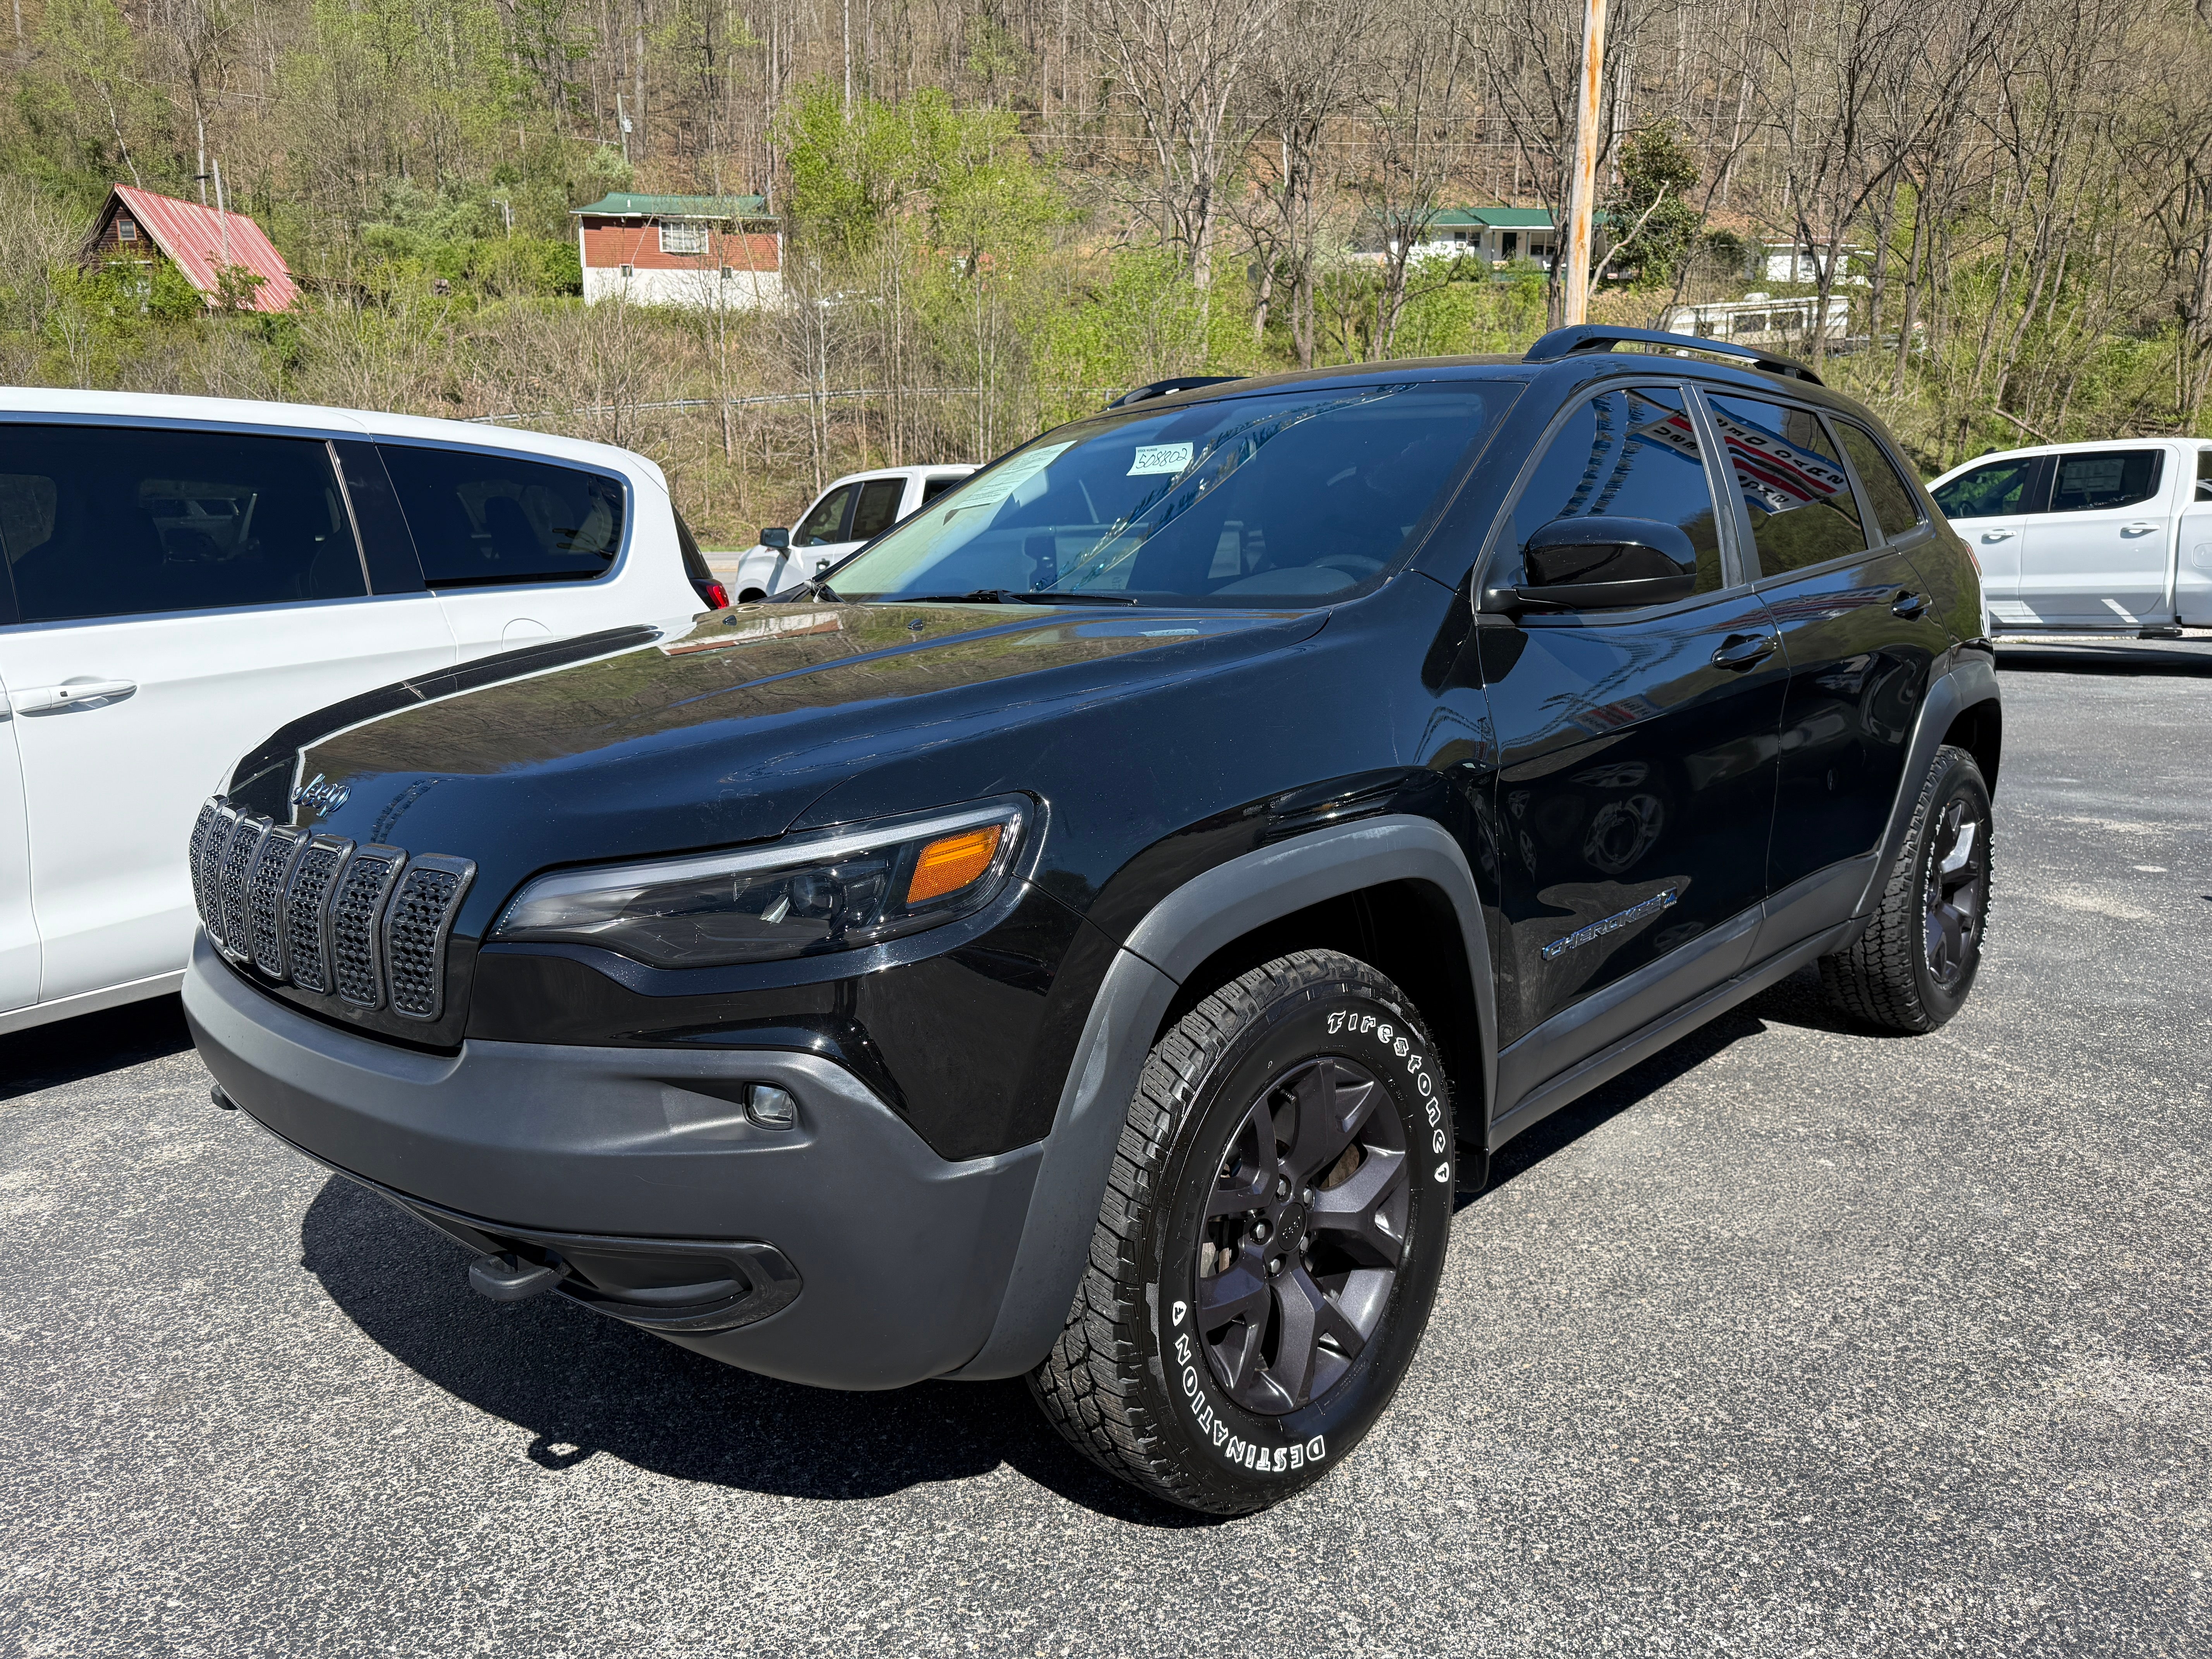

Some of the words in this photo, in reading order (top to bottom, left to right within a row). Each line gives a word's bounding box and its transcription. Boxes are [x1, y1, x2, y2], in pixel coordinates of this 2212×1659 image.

[1135, 448, 1188, 469] 508802
[290, 773, 351, 818] Jeep
[1541, 893, 1661, 961] CHEROKEE
[1327, 1009, 1447, 1154] Firestone
[1174, 1333, 1326, 1472] DESTINATION
